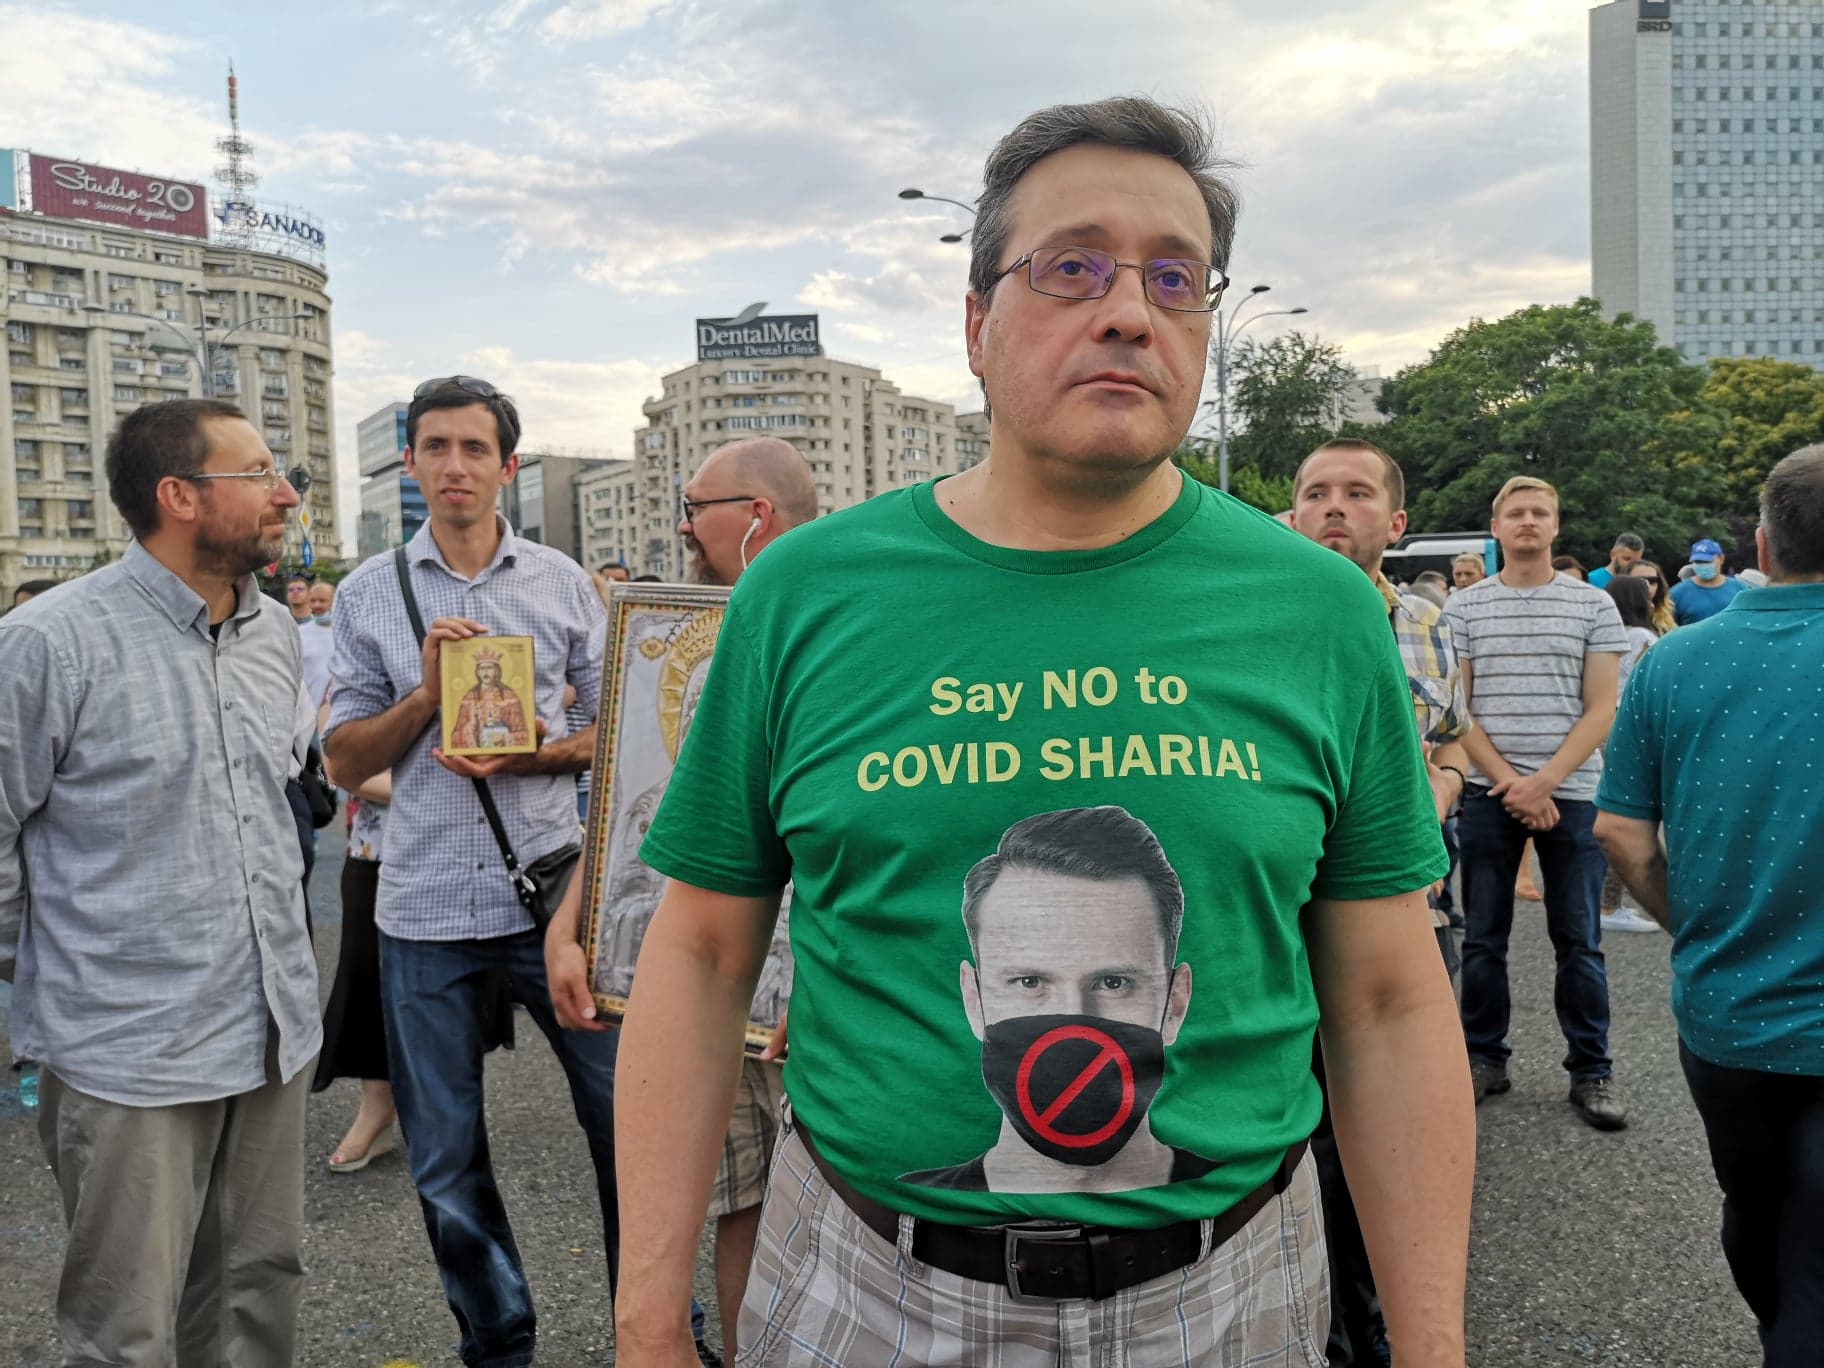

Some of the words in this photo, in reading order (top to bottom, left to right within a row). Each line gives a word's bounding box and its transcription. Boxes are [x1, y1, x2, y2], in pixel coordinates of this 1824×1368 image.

[51, 163, 142, 200] Studio
[146, 181, 194, 212] 20
[246, 209, 325, 245] SANADOR
[699, 321, 817, 346] DentalMed
[745, 343, 782, 357] Dental
[784, 342, 817, 355] Clinic
[930, 676, 1023, 722] Say
[1043, 666, 1118, 710] NO
[1134, 667, 1188, 705] to
[857, 741, 1021, 792] COVID
[1039, 734, 1262, 782] SHARIA!
